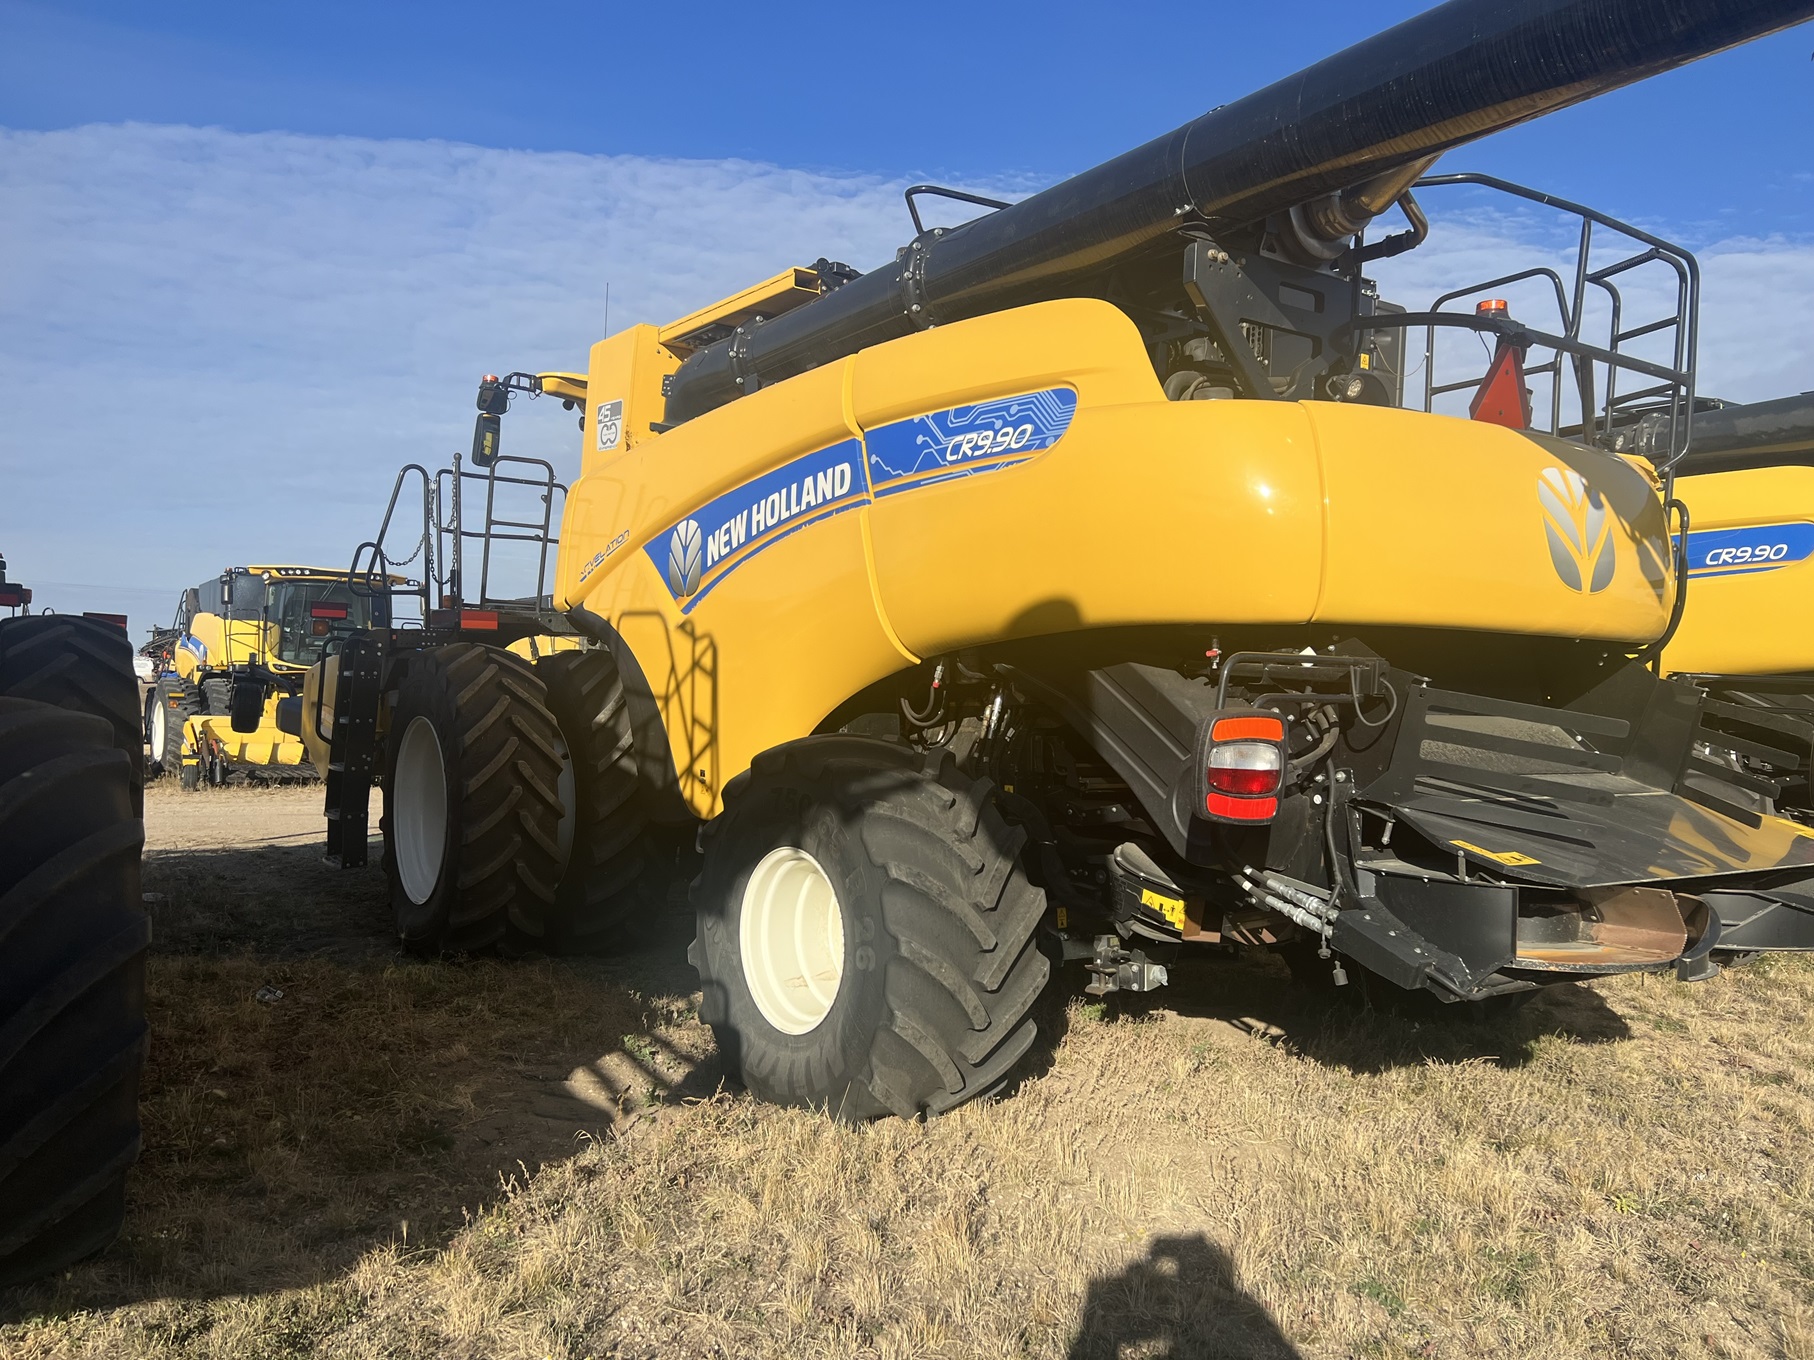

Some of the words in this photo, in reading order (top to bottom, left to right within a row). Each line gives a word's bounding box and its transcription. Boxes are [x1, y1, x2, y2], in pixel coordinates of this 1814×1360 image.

[946, 423, 1035, 462] CR9.90
[707, 509, 748, 567] NEW
[752, 462, 851, 536] HOLLAND
[1705, 543, 1788, 565] CR9.90
